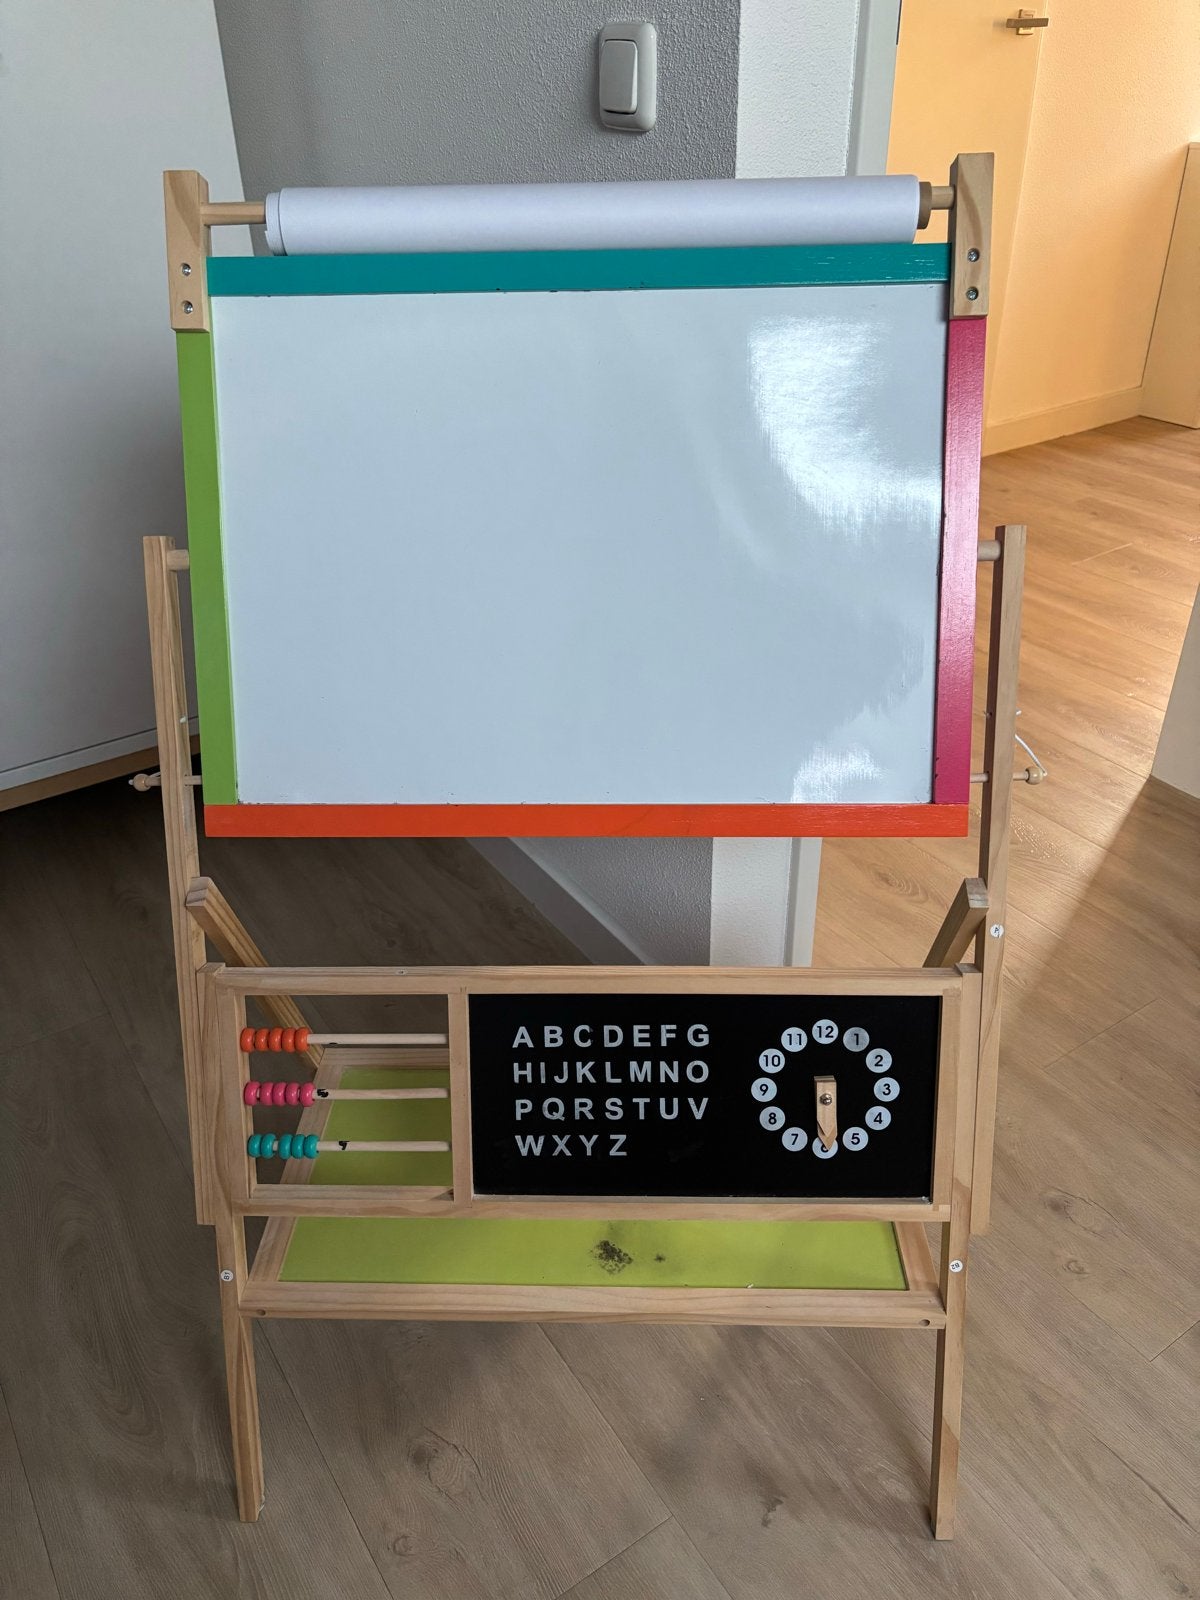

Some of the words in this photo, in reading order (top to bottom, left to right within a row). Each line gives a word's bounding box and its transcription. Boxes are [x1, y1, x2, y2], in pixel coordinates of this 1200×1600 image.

[816, 1025, 834, 1038] 12
[786, 1033, 802, 1046] 11
[853, 1033, 860, 1046] 1
[763, 1054, 781, 1067] 10
[873, 1054, 884, 1067] 2
[759, 1083, 769, 1096] 9
[882, 1083, 892, 1096] 3
[767, 1112, 777, 1125] 8
[873, 1112, 883, 1125] 4
[791, 1133, 799, 1146] 7
[850, 1132, 861, 1146] 5
